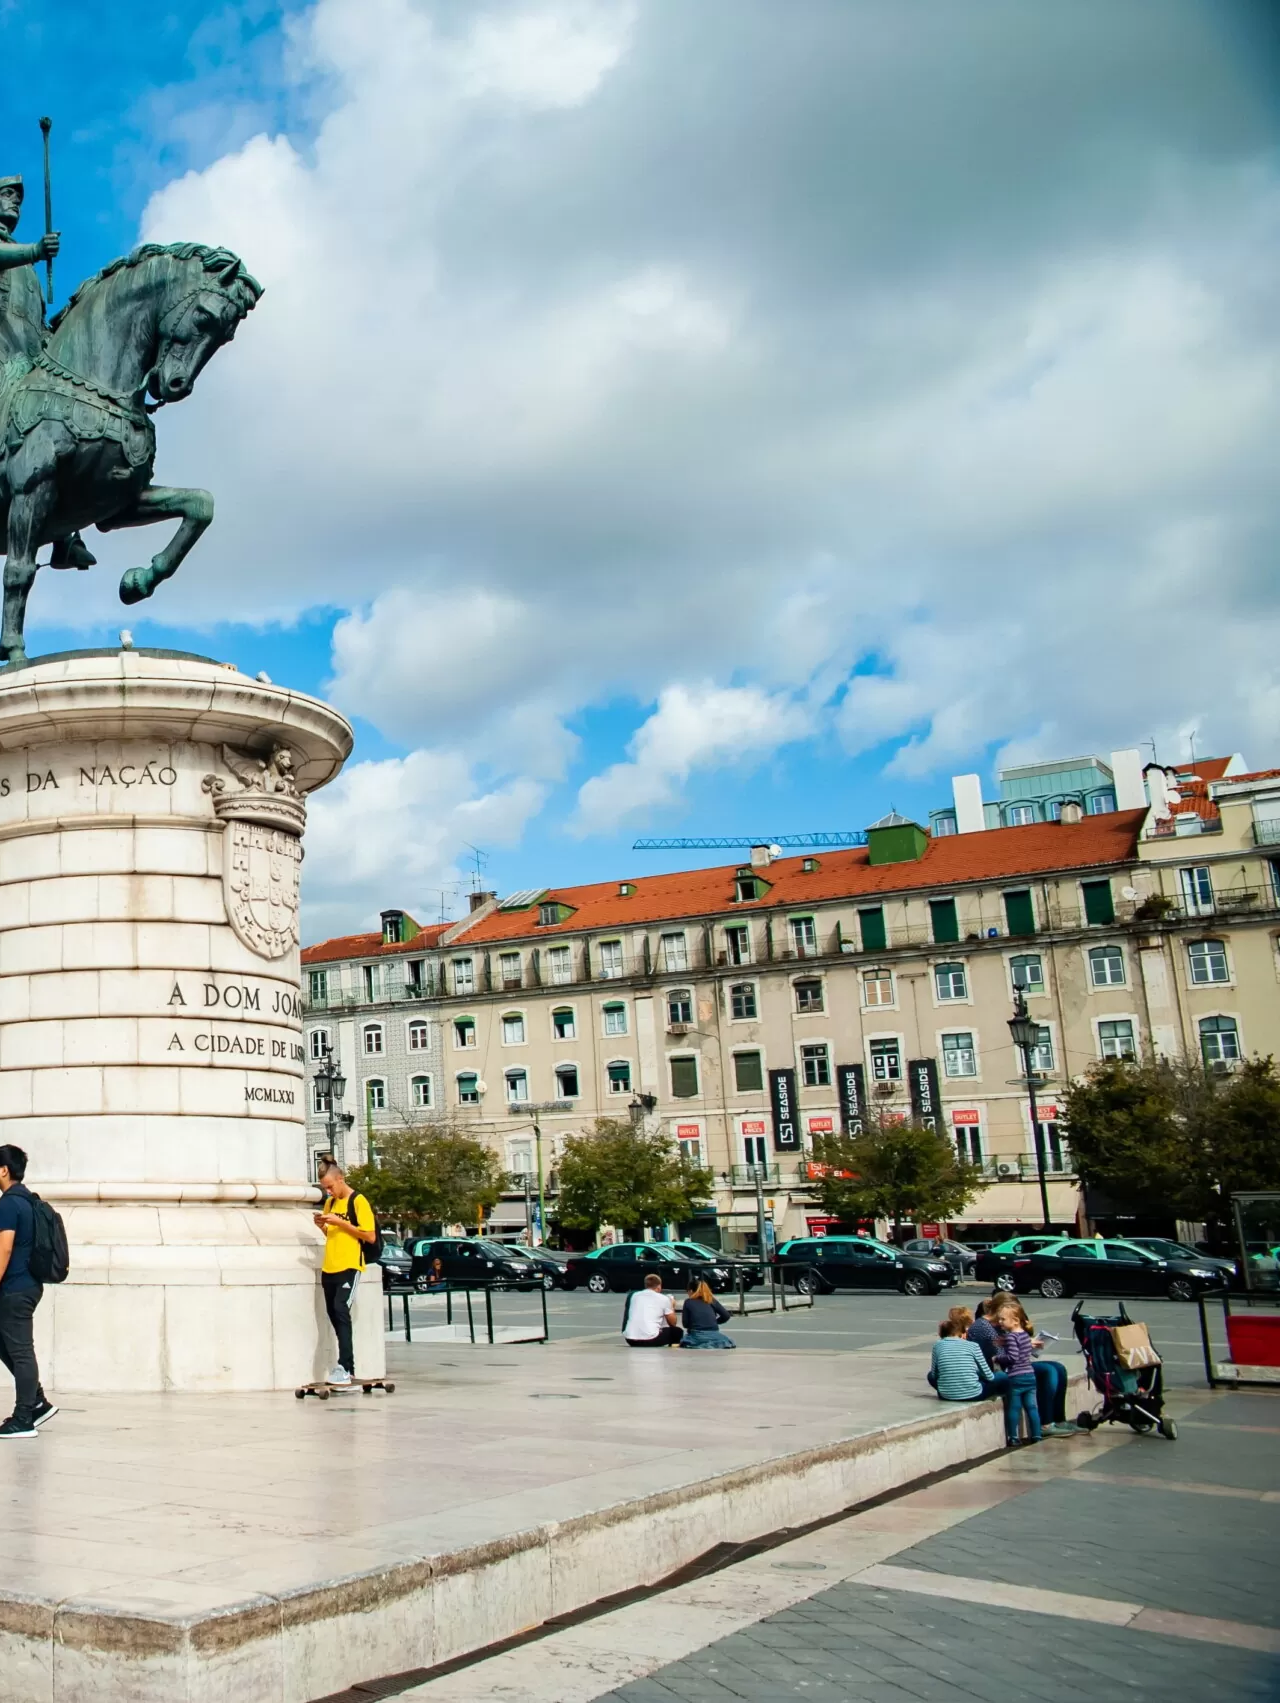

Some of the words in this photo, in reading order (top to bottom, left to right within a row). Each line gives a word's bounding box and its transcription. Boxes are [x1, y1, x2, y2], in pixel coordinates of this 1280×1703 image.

[26, 769, 60, 793] DA
[79, 760, 178, 789] NAÇÃO
[167, 982, 187, 1006] A
[203, 983, 261, 1011] DOM
[167, 1032, 185, 1051] A
[194, 1034, 265, 1056] CIDADE
[271, 1040, 287, 1060] DE
[244, 1086, 295, 1105] MCMLXXI
[777, 1076, 790, 1120] SEASIDE
[846, 1071, 859, 1116] SEASIDE
[918, 1067, 932, 1113] SEASIDE
[954, 1113, 977, 1121] OUTLET
